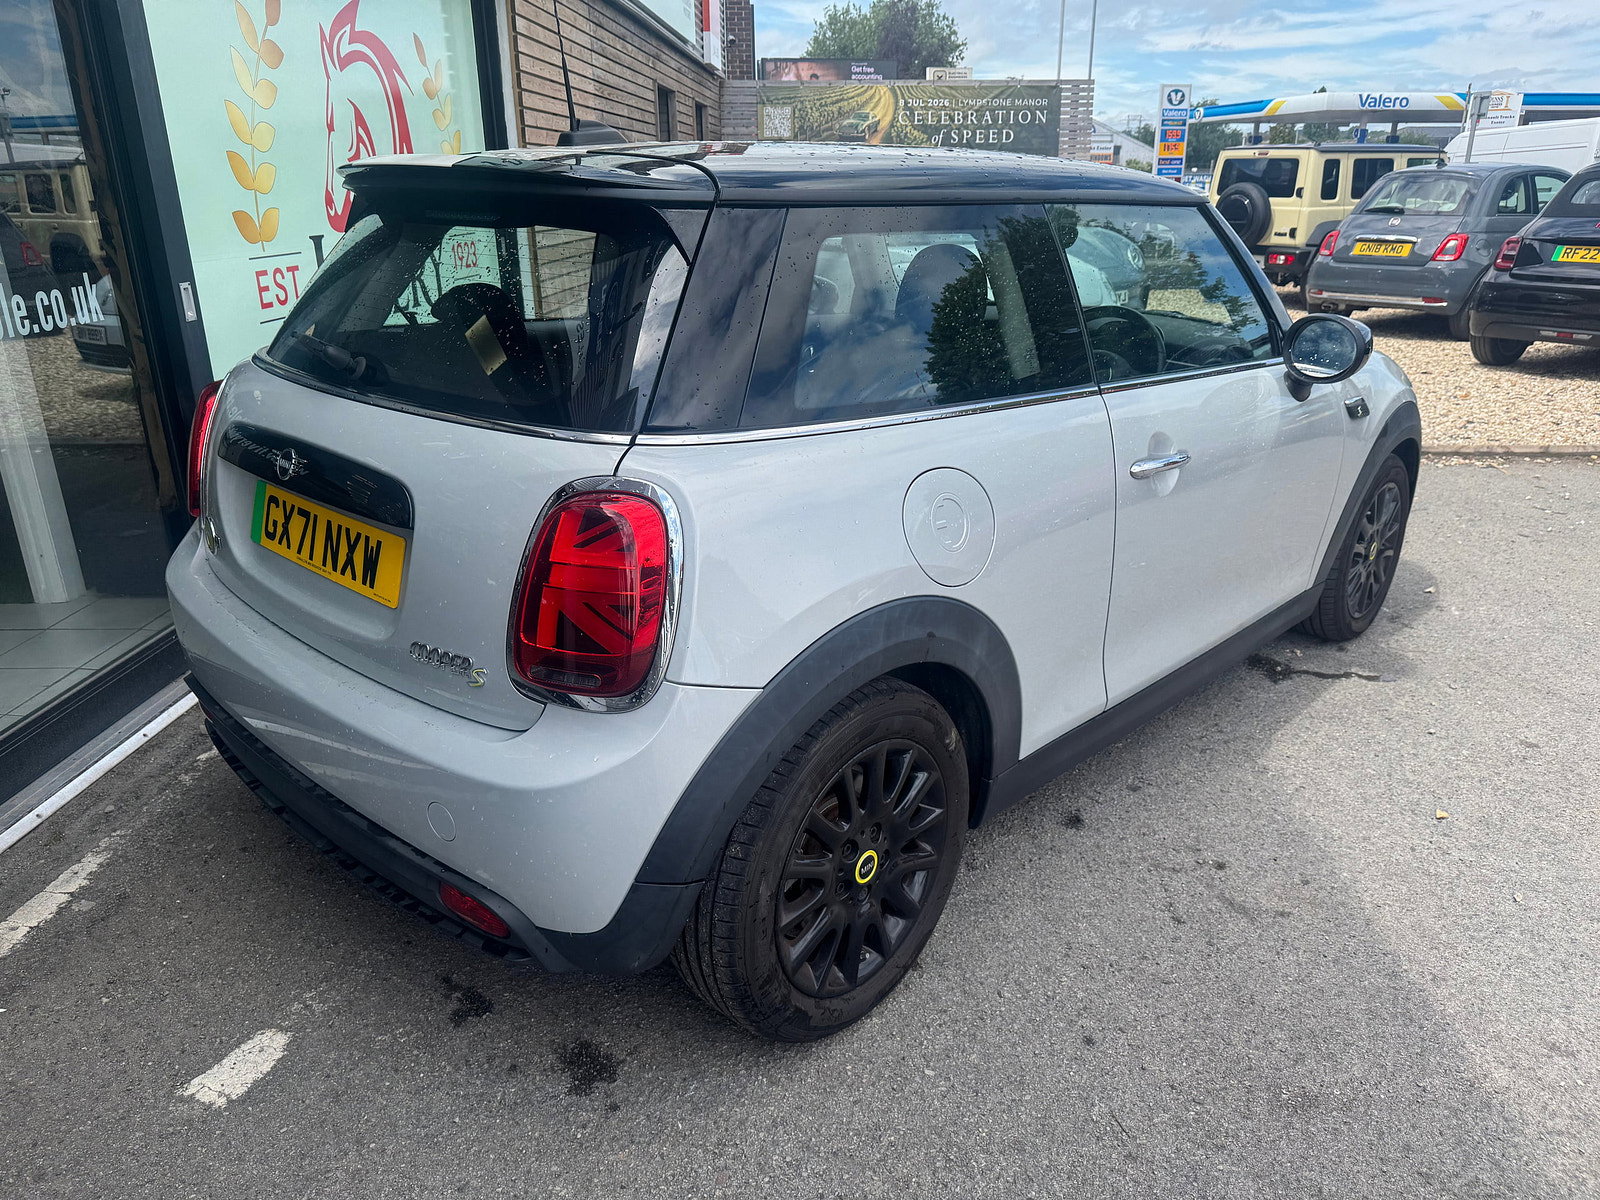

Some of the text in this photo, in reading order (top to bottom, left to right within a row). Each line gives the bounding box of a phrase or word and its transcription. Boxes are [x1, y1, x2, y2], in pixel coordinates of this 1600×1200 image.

[908, 99, 925, 107] JUL
[928, 99, 950, 107] 2026
[958, 99, 1012, 107] LYMPSTONE
[1015, 99, 1048, 107] MANOR
[1358, 93, 1410, 110] Valero
[898, 110, 1048, 125] CELEBRATION
[1162, 108, 1187, 117] Valero
[931, 129, 1014, 147] of SPEED
[1360, 243, 1404, 255] GN18 KMO
[1561, 247, 1600, 260] RF22
[255, 241, 478, 310] EST 1923
[0, 271, 105, 341] le.co.uk
[264, 494, 383, 590] GX71 NXW
[409, 641, 488, 687] COOPER S
[861, 860, 874, 875] MINI
